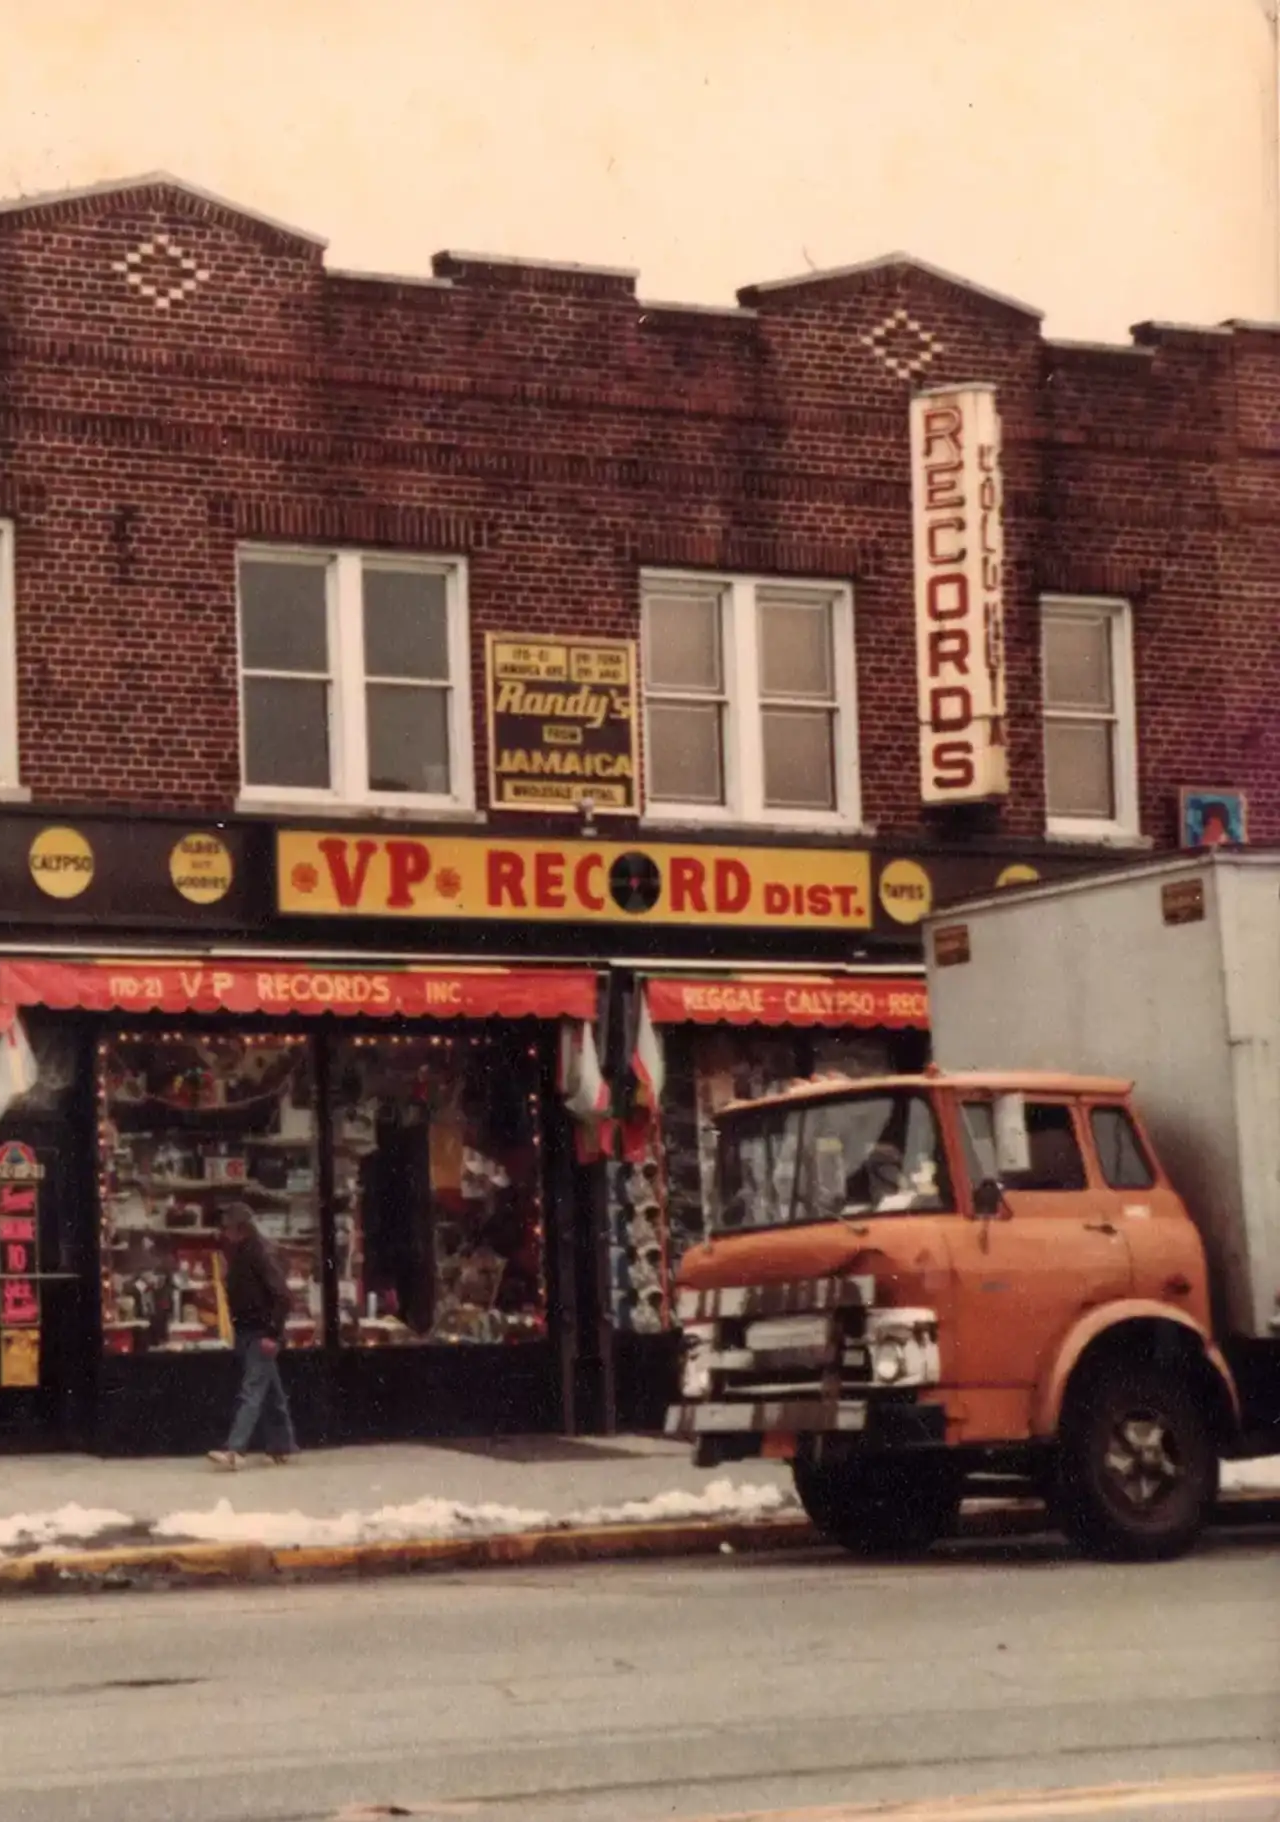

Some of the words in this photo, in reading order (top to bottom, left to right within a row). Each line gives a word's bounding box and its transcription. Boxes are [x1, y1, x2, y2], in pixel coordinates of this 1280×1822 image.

[922, 408, 975, 789] RECORDS
[496, 680, 632, 729] Randy's
[496, 749, 634, 777] JAMAICA
[31, 854, 93, 872] CALYPSO
[318, 838, 431, 909] VP
[486, 849, 752, 916] RECORD
[764, 883, 865, 918] DIST.
[426, 981, 474, 1004] INC.
[682, 987, 765, 1012] REGGAE
[784, 990, 874, 1015] CALYPSO
